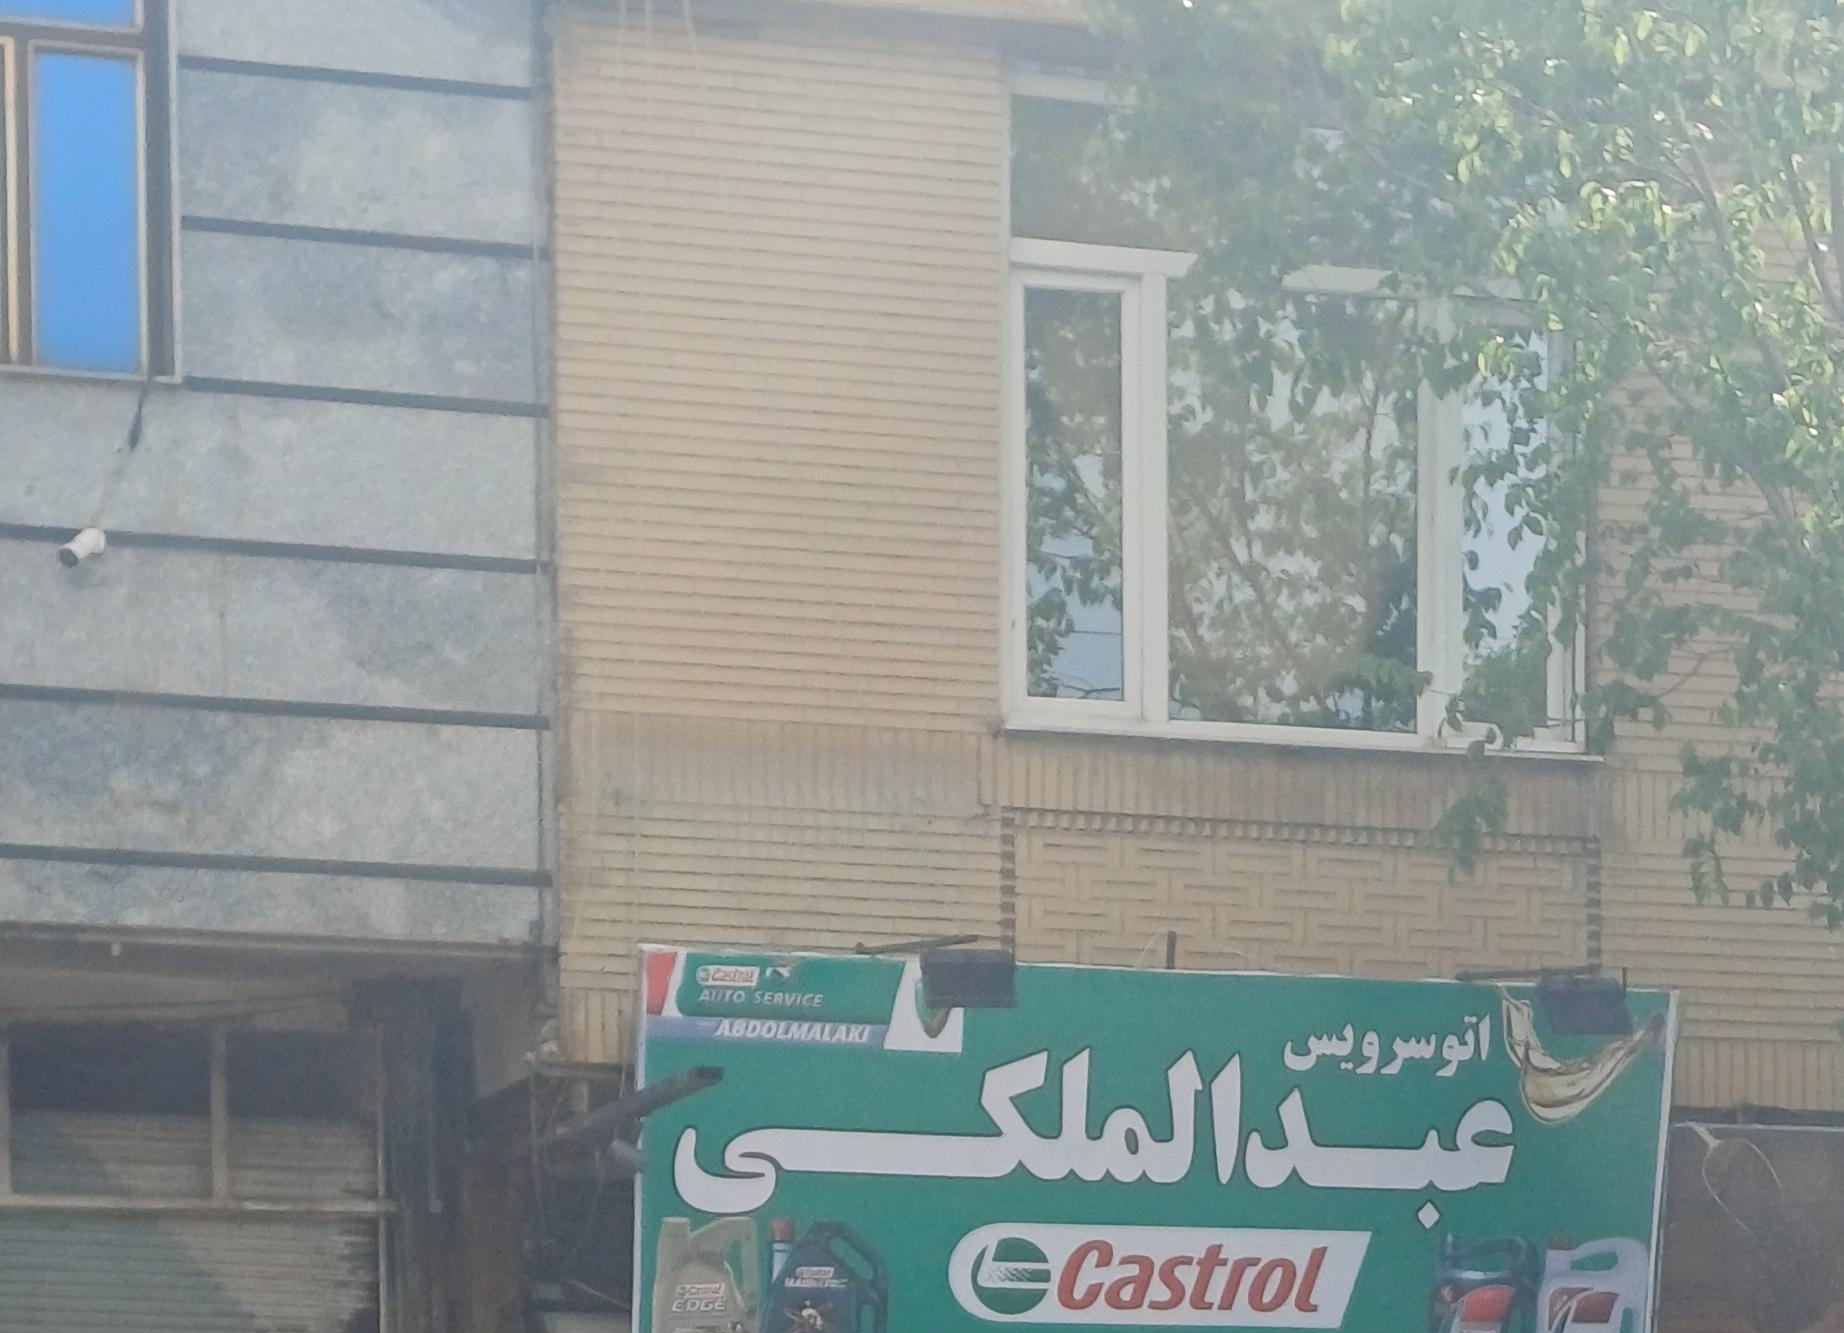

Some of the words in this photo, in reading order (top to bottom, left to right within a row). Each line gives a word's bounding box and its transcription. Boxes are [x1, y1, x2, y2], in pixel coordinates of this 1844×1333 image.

[699, 989, 745, 1004] AUTO
[753, 991, 823, 1007] SERVICE
[716, 1017, 870, 1043] ABDOLMALAKI
[1283, 1013, 1491, 1077] اتوسرویس
[1056, 1239, 1329, 1313] Castrol
[672, 1298, 727, 1311] EDGE
